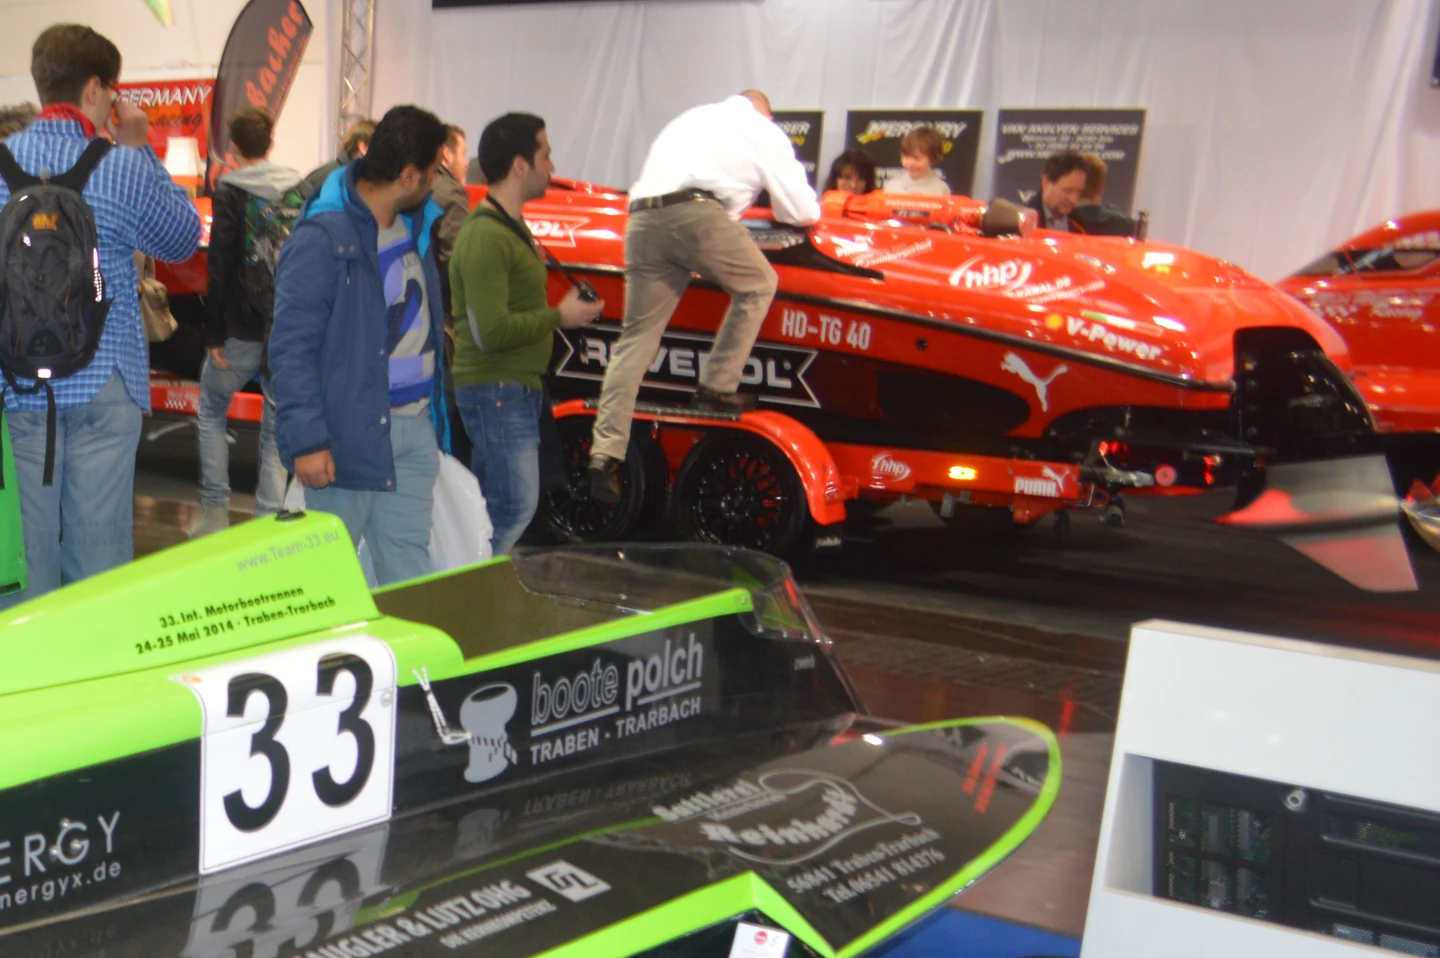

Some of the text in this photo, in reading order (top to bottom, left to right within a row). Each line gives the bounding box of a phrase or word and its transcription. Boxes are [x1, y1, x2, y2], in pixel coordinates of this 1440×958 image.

[117, 84, 213, 107] GERMANY
[864, 120, 968, 138] MERRY
[782, 308, 871, 351] HD-TG 40
[1066, 315, 1162, 361] V-Power
[577, 337, 792, 389] RVEOL
[236, 528, 340, 573] www.Team-33.eu
[135, 595, 336, 654] 24-25 Mai 2014 Traben-Trarbach
[181, 610, 203, 623] Int.
[205, 586, 305, 617] Motorbootrennen
[530, 632, 704, 726] boote polch
[222, 651, 375, 834] 33
[530, 696, 702, 765] TRABEN TRARBACH
[396, 915, 433, 938] &
[417, 896, 488, 930] LUTZ
